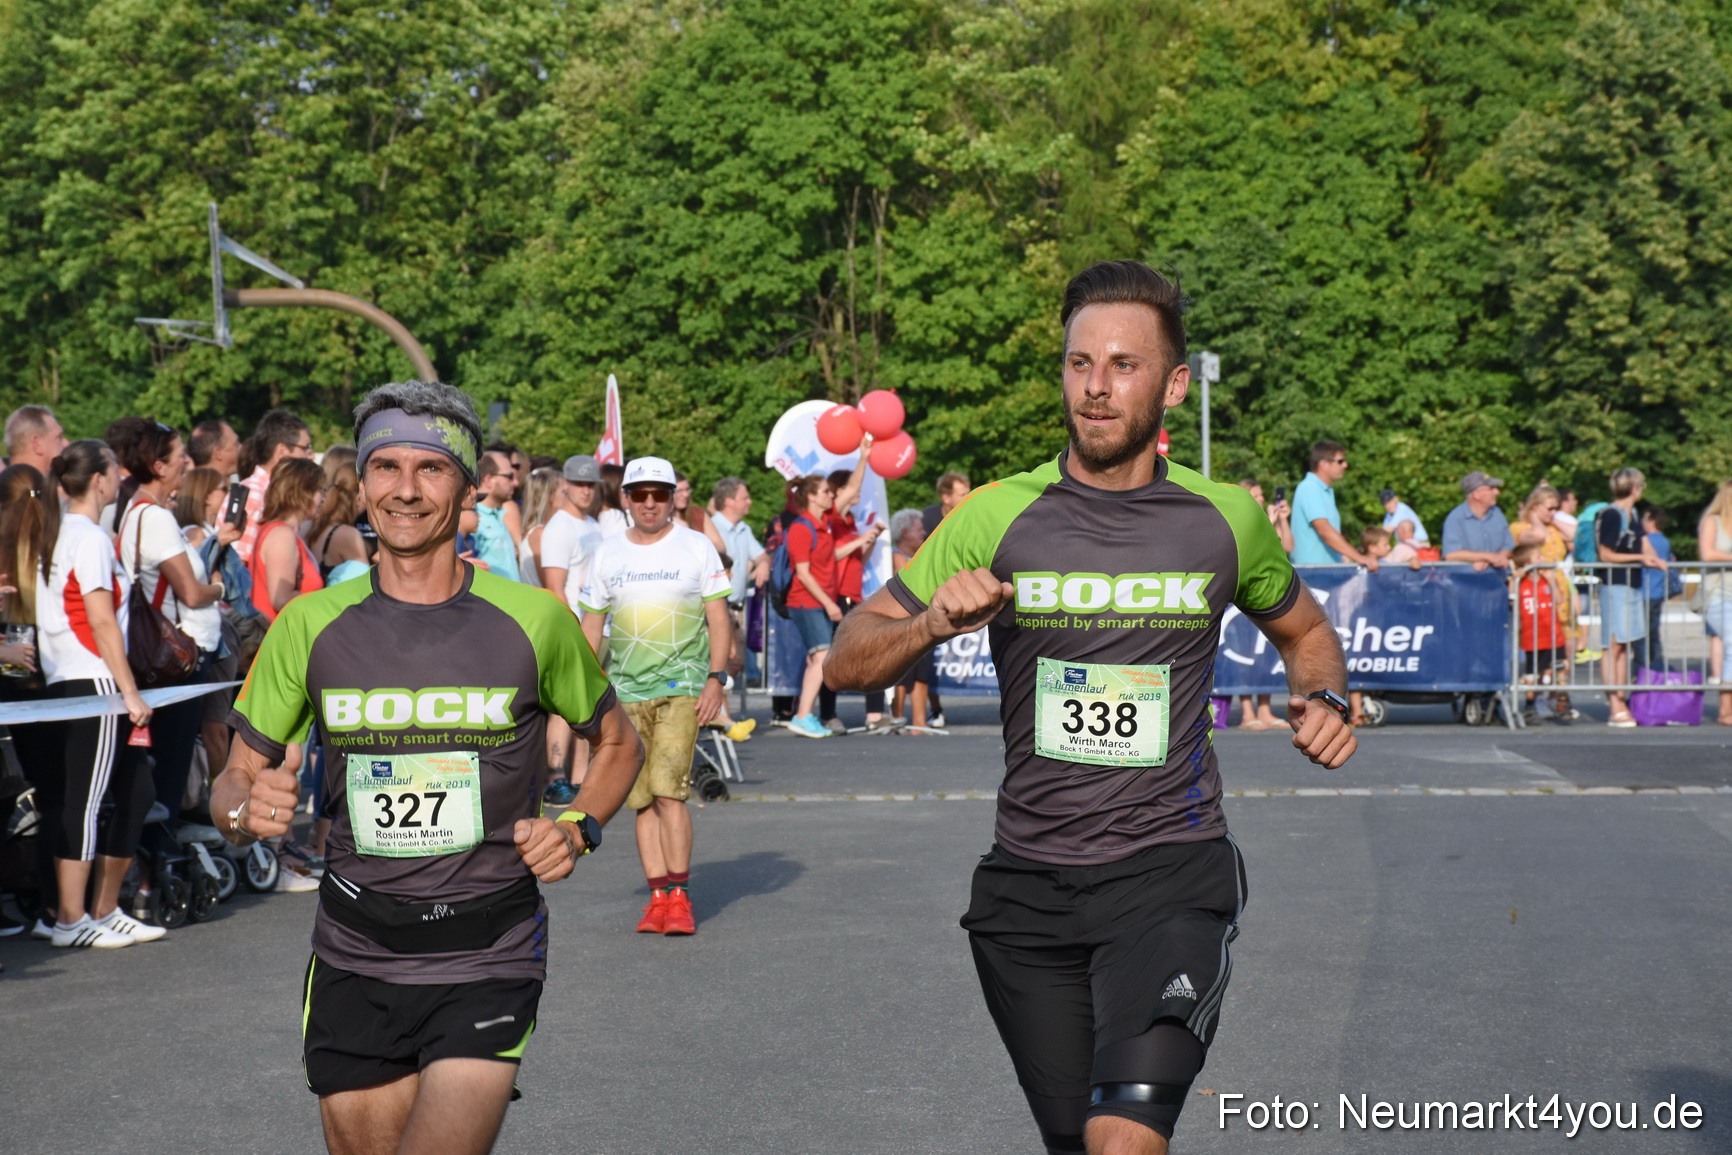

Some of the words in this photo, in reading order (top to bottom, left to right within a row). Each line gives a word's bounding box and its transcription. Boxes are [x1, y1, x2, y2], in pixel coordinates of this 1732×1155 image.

[626, 569, 680, 582] firmenlauf
[1014, 574, 1211, 611] BOCK
[1015, 615, 1068, 630] inspired
[1074, 616, 1092, 631] by
[1097, 617, 1145, 629] smart
[1150, 616, 1209, 631] concepts
[1055, 680, 1107, 694] firmenlauf
[1118, 694, 1134, 702] run
[1138, 693, 1161, 701] 2019
[323, 689, 516, 730] BOCK
[1062, 699, 1138, 738] 338
[330, 733, 374, 748] inspired
[379, 733, 397, 747] by
[403, 732, 449, 744] smart
[455, 731, 516, 747] concepts
[1069, 736, 1096, 747] Wirth
[1099, 739, 1131, 749] Marco
[1060, 744, 1076, 753] Bock
[1084, 748, 1106, 756] GmbH
[363, 775, 413, 786] firmenlauf
[425, 782, 442, 790] run
[446, 780, 471, 789] 2019
[373, 792, 447, 828] 327
[375, 830, 417, 840] Rosinski
[420, 829, 453, 838] Martin
[398, 840, 419, 848] GmbH
[1161, 988, 1197, 1000] adidas
